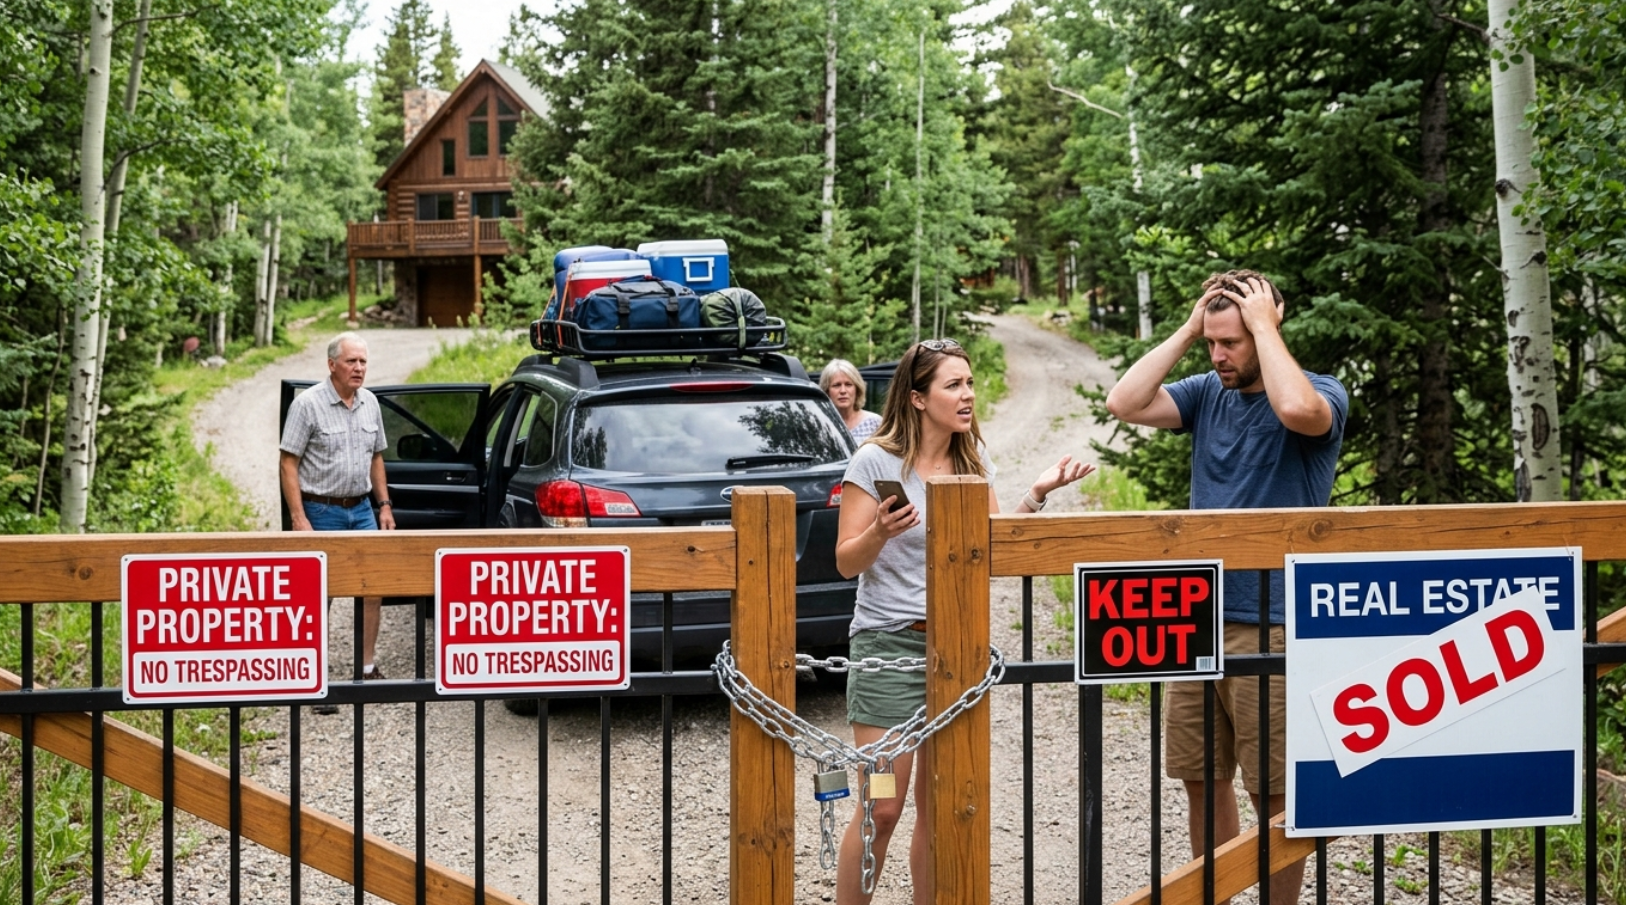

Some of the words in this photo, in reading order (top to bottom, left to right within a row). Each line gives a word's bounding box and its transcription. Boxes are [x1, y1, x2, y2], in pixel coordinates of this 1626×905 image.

[159, 565, 291, 602] PRIVATE
[470, 559, 596, 595] PRIVATE
[1089, 576, 1210, 620] KEEP
[1310, 581, 1410, 618] REAL
[136, 606, 314, 644] PROPERTY:
[449, 598, 618, 636] PROPERTY:
[452, 651, 478, 675] NO
[486, 648, 614, 674] TRESPASSING
[1101, 624, 1196, 667] OUT
[141, 660, 168, 685] NO
[175, 657, 310, 683] TRESPASSING
[1332, 609, 1545, 753] SOLD
